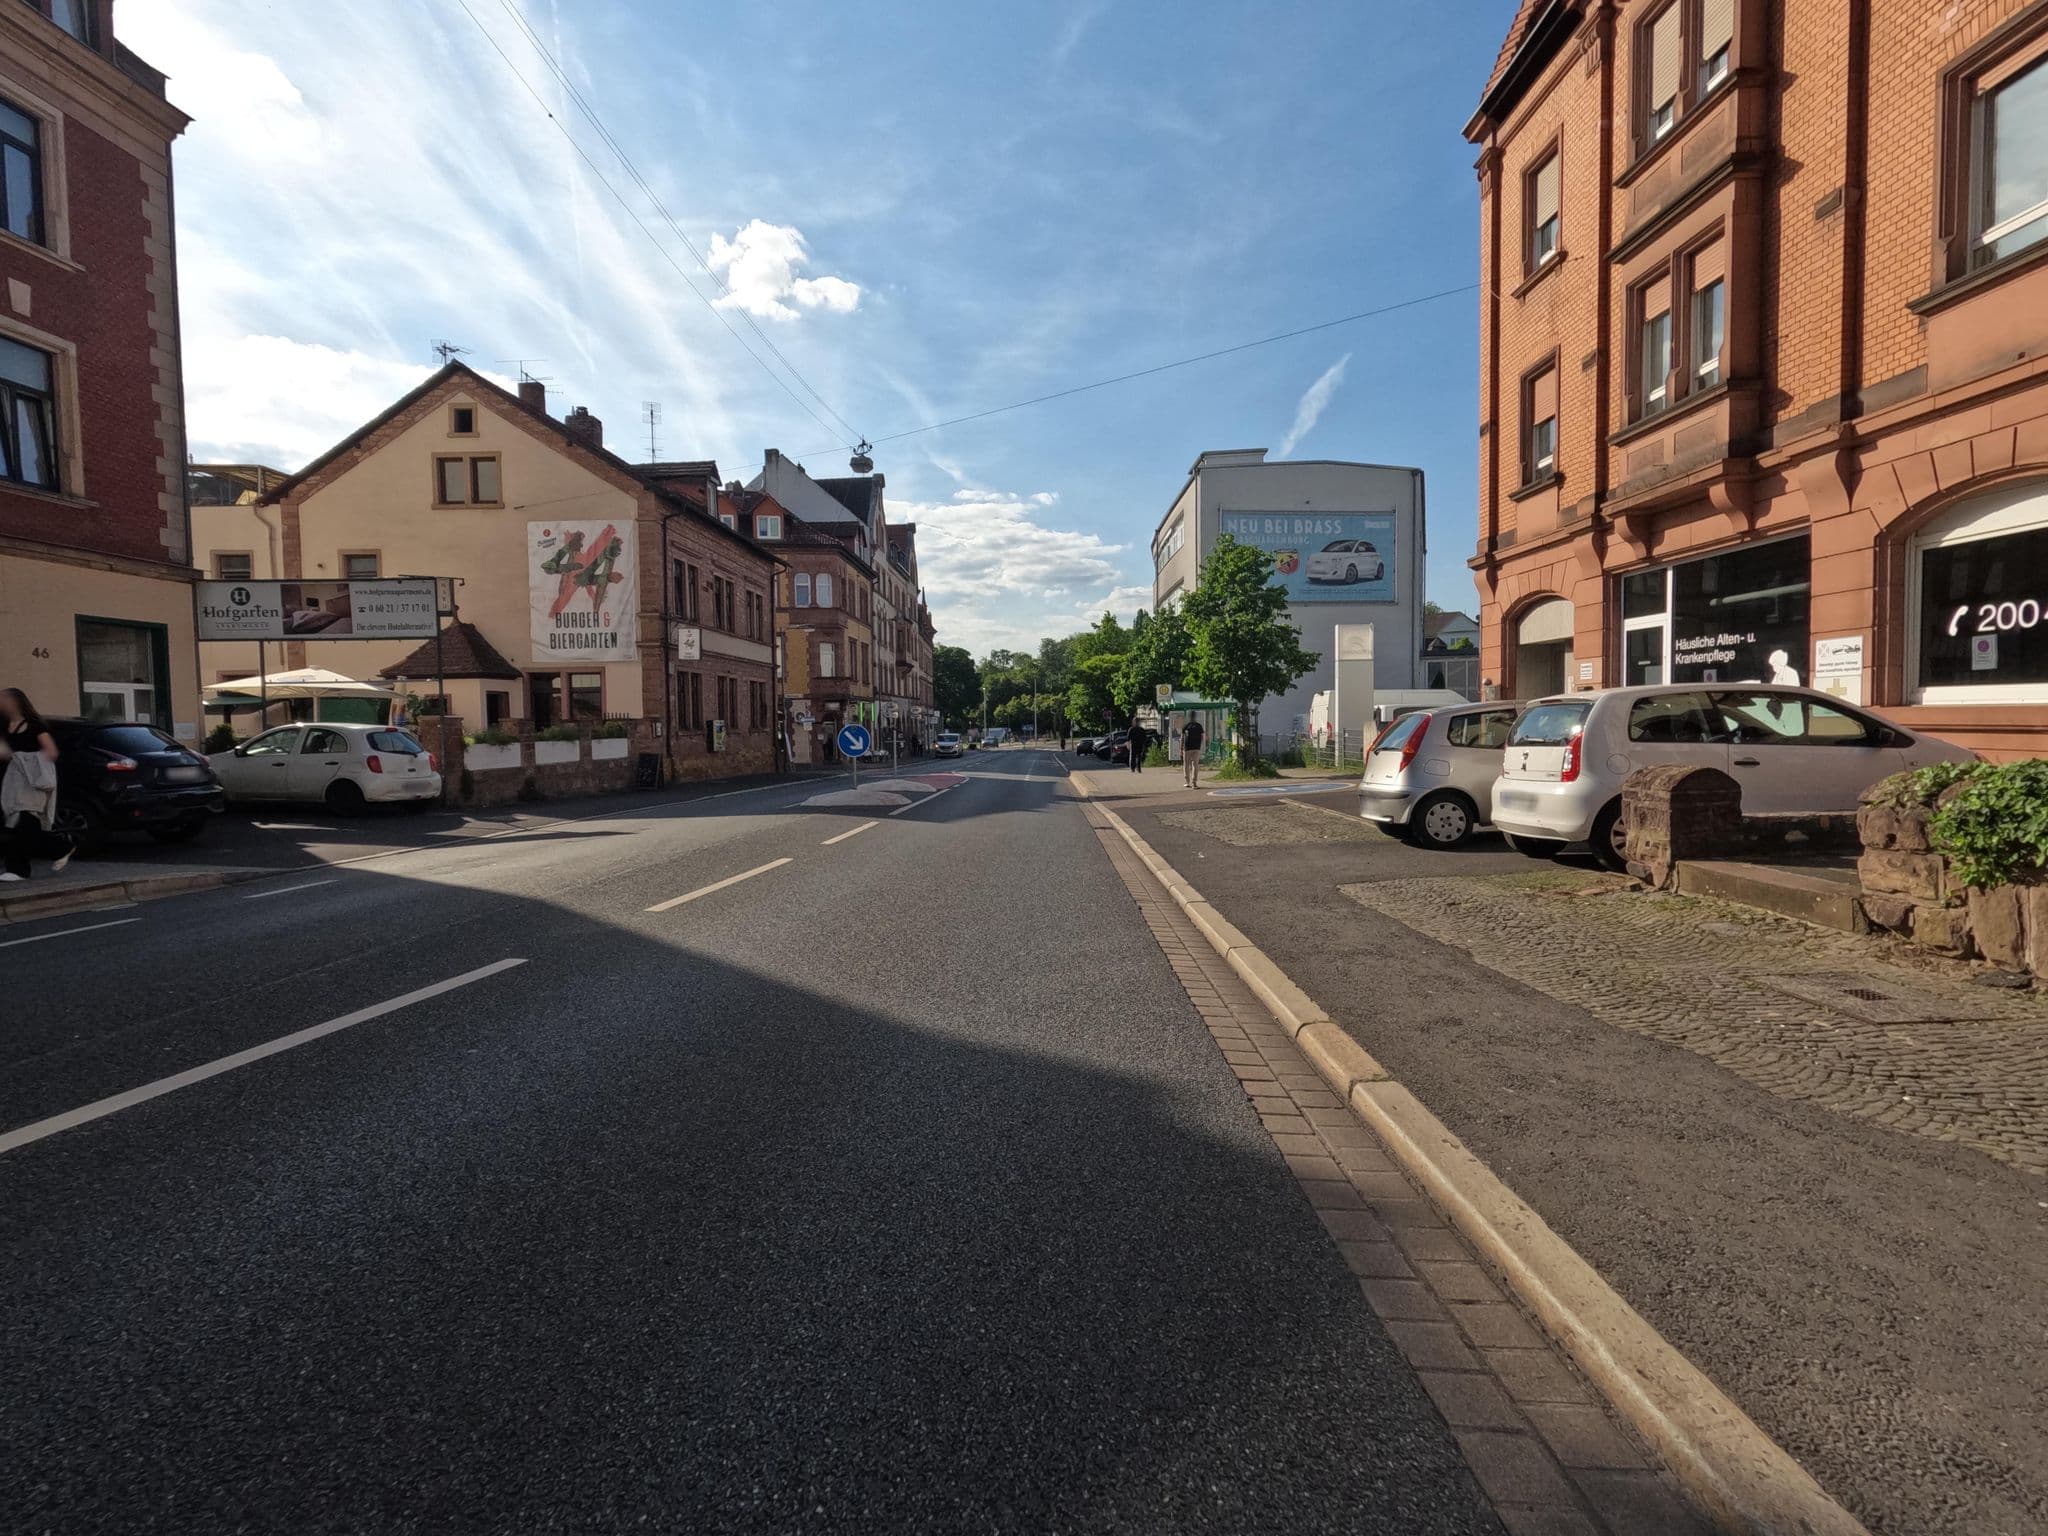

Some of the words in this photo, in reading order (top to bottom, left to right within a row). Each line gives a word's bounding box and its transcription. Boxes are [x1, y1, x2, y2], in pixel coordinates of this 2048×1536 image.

[1227, 519, 1258, 533] NEU
[1264, 518, 1288, 534] BEI
[1294, 519, 1342, 535] BRASS
[203, 604, 280, 621] Hofgarten
[386, 603, 394, 613] 21
[421, 603, 430, 613] 01
[1977, 599, 2048, 632] 200
[555, 612, 599, 629] BURGER
[603, 611, 611, 628] &
[550, 631, 618, 650] BIERGARTEN
[1675, 635, 1715, 651] Häusliche
[1716, 633, 1745, 647] Alten-
[1747, 632, 1757, 643] u.
[31, 647, 50, 659] 46
[1675, 649, 1736, 665] Krankenpflege
